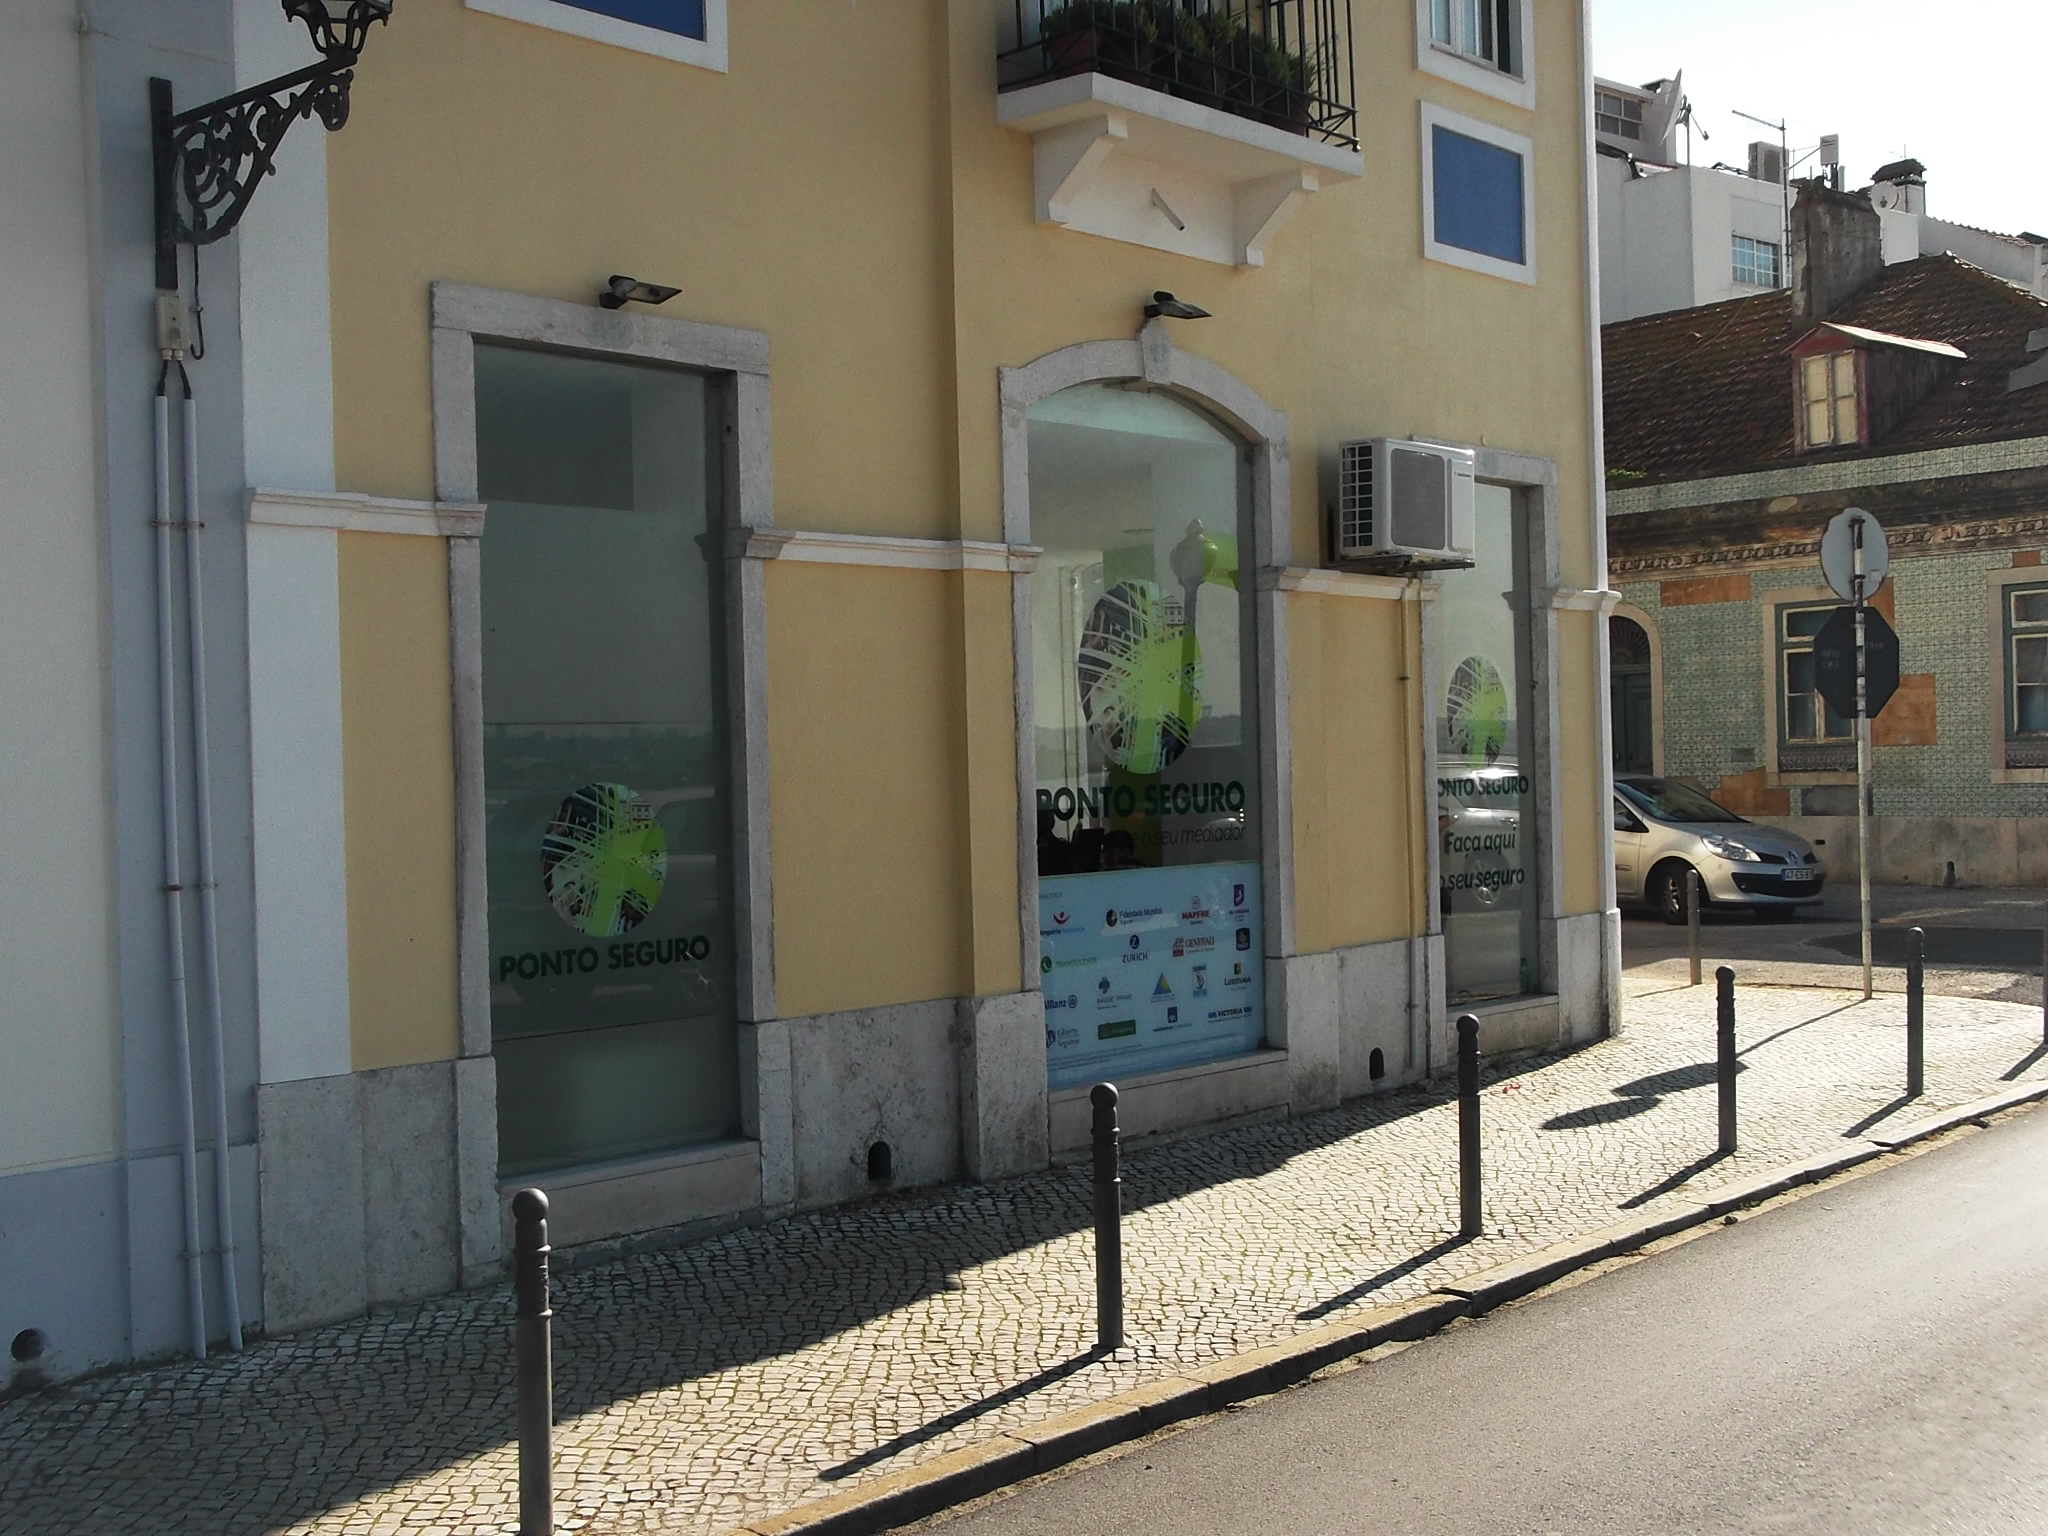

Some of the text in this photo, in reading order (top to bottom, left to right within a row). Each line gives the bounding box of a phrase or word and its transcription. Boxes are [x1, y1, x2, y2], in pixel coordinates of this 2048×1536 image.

[1438, 775, 1529, 797] ONTO SEGURO
[1036, 781, 1245, 821] PONTO SEGURO
[1155, 829, 1178, 845] seu
[1182, 823, 1246, 844] mediador
[1444, 828, 1516, 858] Faça aqui
[1448, 871, 1473, 891] seu
[1475, 868, 1525, 892] seguro
[1182, 909, 1210, 920] MAPFRE
[1185, 936, 1215, 948] GENERALI
[500, 935, 711, 981] PONTO SEGURO
[1122, 952, 1148, 963] ZURICH
[1224, 976, 1252, 986] LUSITANIA
[1217, 1007, 1243, 1017] VICTORIA
